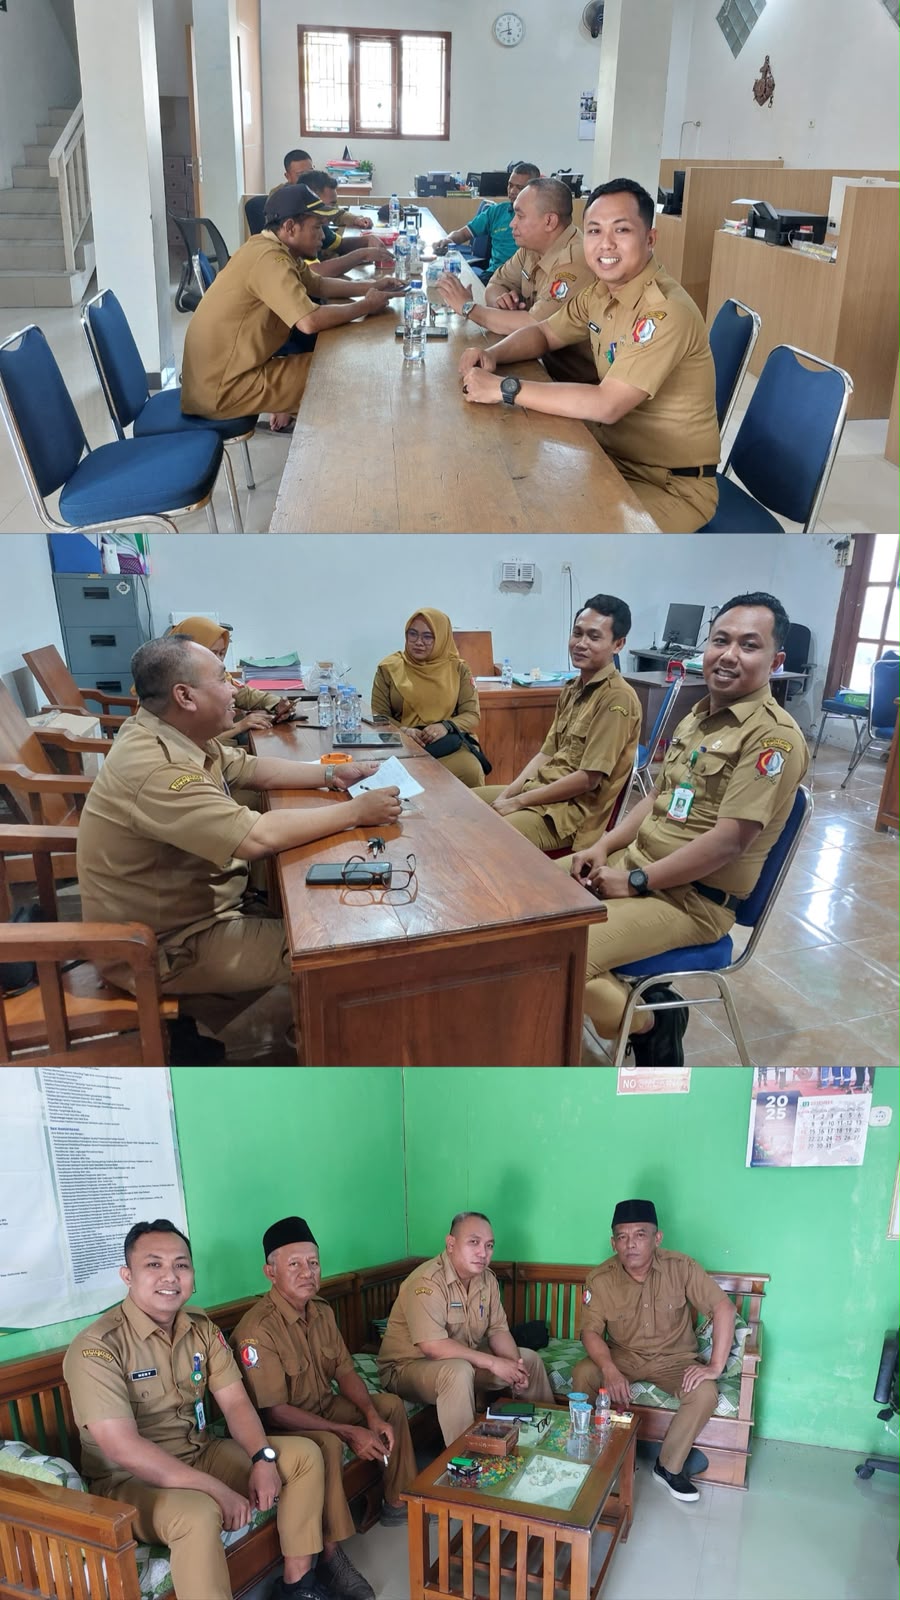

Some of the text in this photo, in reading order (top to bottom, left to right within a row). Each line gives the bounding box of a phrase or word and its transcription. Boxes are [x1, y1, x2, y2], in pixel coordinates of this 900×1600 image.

[623, 1079, 636, 1089] NO
[766, 1095, 789, 1108] 20
[765, 1108, 787, 1120] 25
